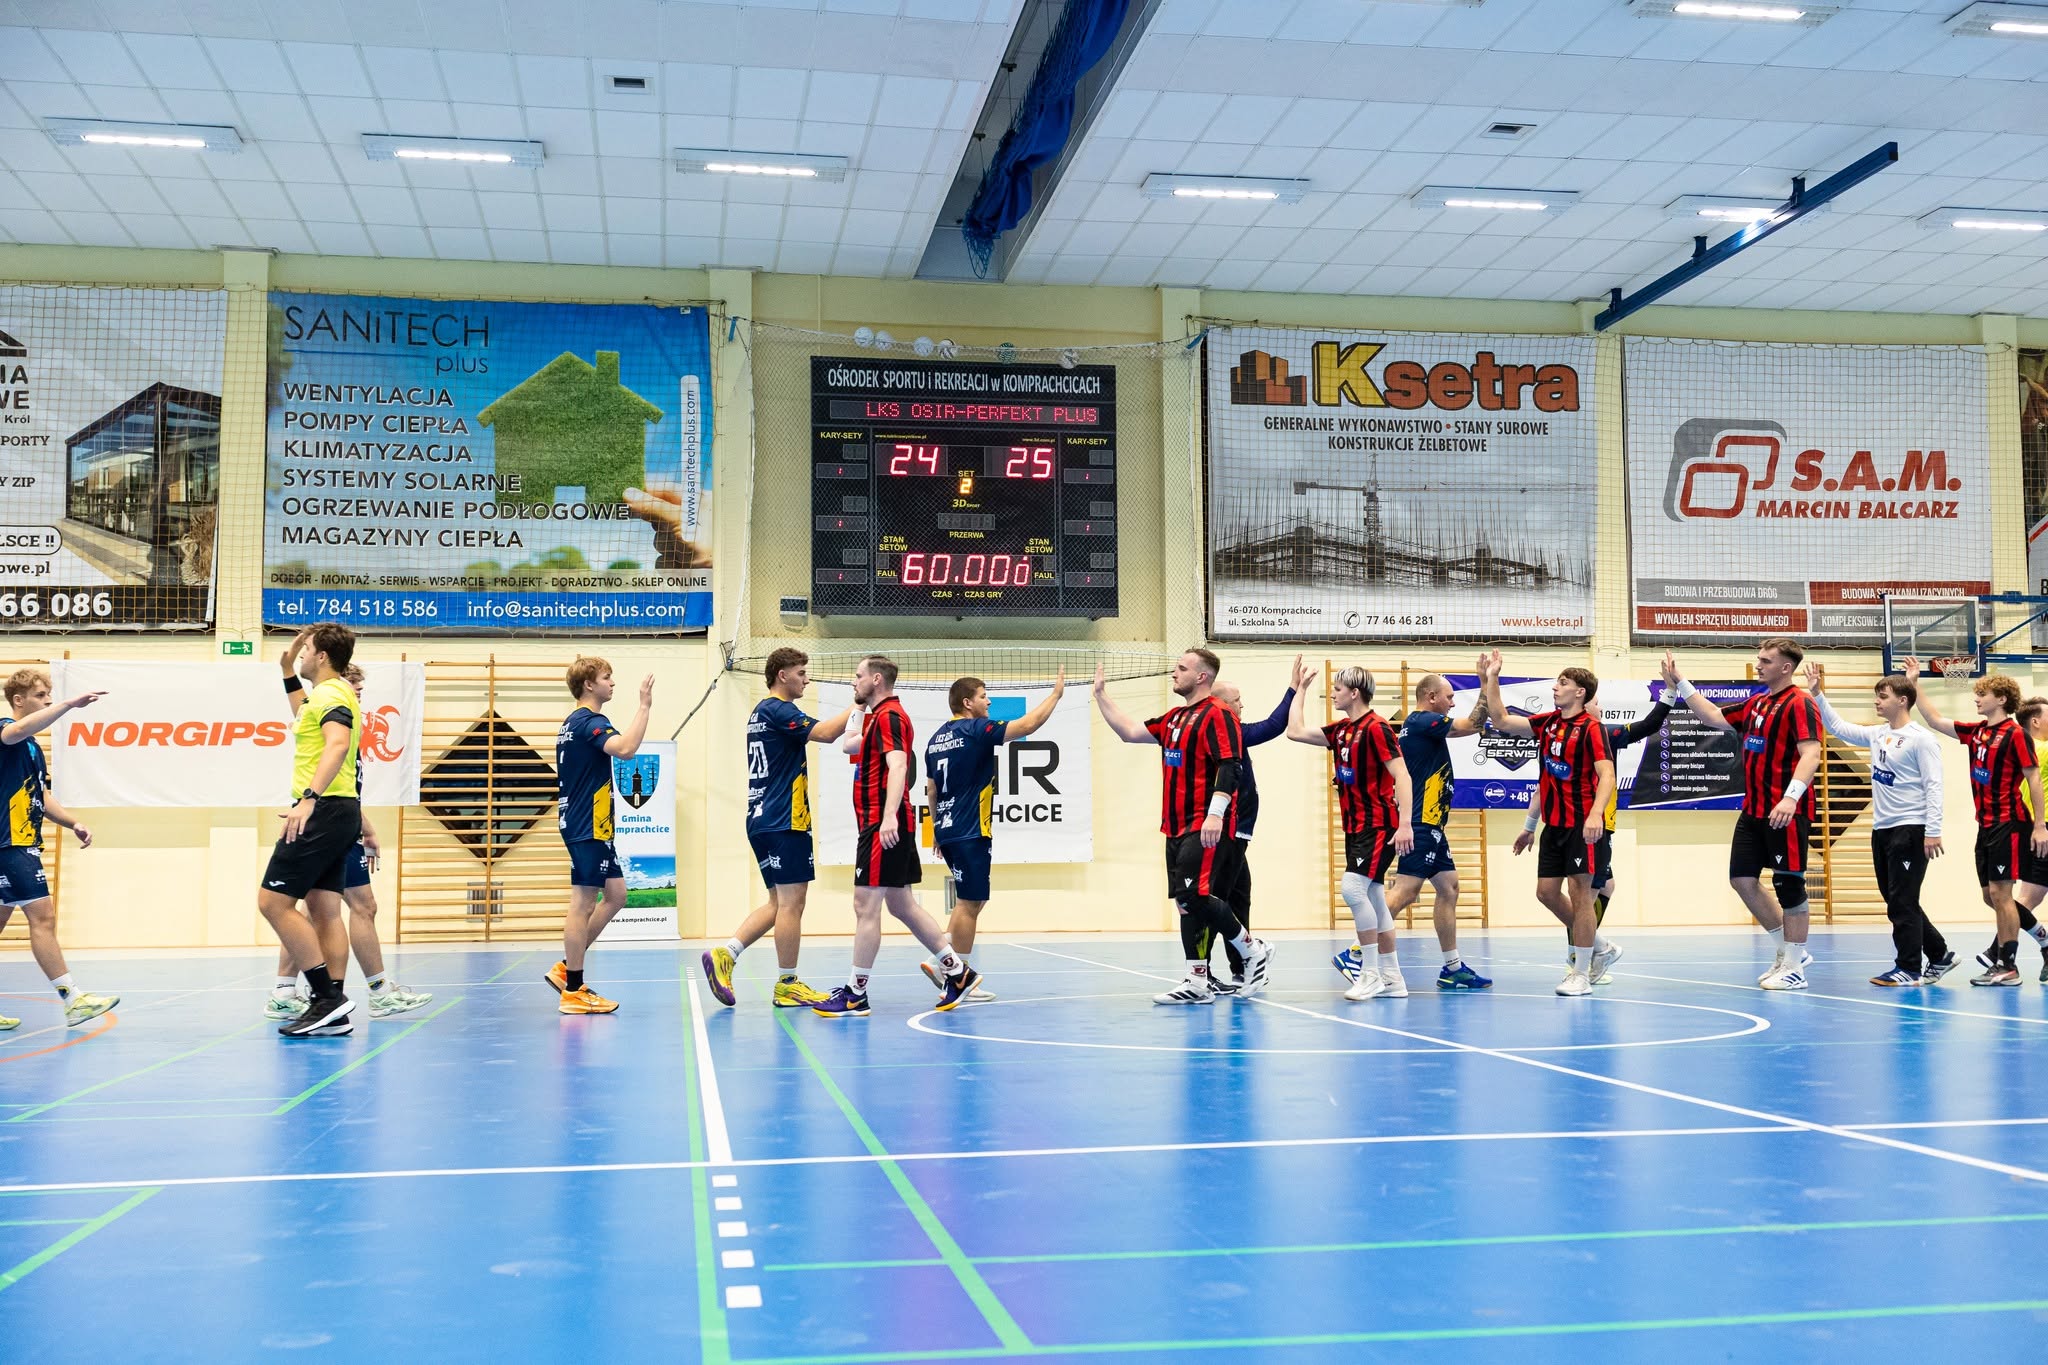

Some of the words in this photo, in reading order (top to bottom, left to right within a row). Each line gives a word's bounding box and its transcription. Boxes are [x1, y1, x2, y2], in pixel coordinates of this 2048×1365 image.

[436, 354, 489, 376] plus
[828, 363, 879, 388] OŚRODEK
[883, 370, 925, 389] SPORTU
[928, 371, 932, 389] i
[934, 372, 988, 391] REKREACJI
[990, 377, 1000, 391] w
[1003, 374, 1100, 394] KOMPRACHCICACH
[1312, 341, 1580, 412] Ksetra
[284, 383, 454, 407] WENTYLACJA
[4, 415, 30, 424] Król
[866, 402, 900, 417] LKS
[911, 403, 1043, 420] OSIR-PERFEKT
[1054, 407, 1097, 422] PLUS
[284, 412, 374, 433] POMPY
[382, 415, 469, 435] CIEPŁA
[1264, 416, 1334, 432] GENERALNE
[1338, 418, 1443, 434] WYKONAWSTWO
[1454, 420, 1494, 435] STANY
[1497, 421, 1549, 436] SUROWE
[284, 440, 473, 463] KLIMATYZACJA
[1328, 435, 1414, 451] KONSTRUKCJE
[1418, 434, 1488, 453] ŻELBETOWE
[684, 390, 695, 527] www.sanitechplus.com
[890, 444, 939, 475] 24
[1006, 447, 1052, 478] 25
[283, 468, 396, 490] SYSTEMY
[405, 472, 521, 492] SOLARNE
[1790, 449, 1962, 492] S.A.M.
[12, 477, 35, 487] ZIP
[959, 478, 973, 494] 2
[282, 497, 455, 519] OGRZEWANIE
[464, 502, 630, 521] PODŁOGOWE
[1756, 500, 1851, 519] MARCIN
[1858, 501, 1959, 519] BALCARZ
[282, 526, 430, 547] MAGAZYNY
[437, 528, 523, 548] CIEPŁA
[879, 543, 908, 551] SETÓW
[321, 572, 370, 585] MONTAŻ
[379, 575, 420, 586] SERWIS
[429, 576, 485, 587] WSPARCIE
[494, 577, 542, 587] PROJEKT
[552, 577, 622, 587] DORADZTWO
[631, 577, 664, 587] SKLEP
[667, 576, 707, 587] ONLINE
[1664, 585, 1698, 598] BUDOWA
[1703, 586, 1756, 599] PRZEBUDOWA
[1758, 585, 1778, 599] DRÓG
[1841, 587, 1875, 599] BUDOWA
[51, 592, 112, 617] 086
[277, 598, 309, 616] tel.
[316, 598, 352, 616] 784
[359, 600, 395, 617] 518
[402, 600, 438, 617] 586
[468, 600, 685, 622] info@sanitechplus.com
[1228, 606, 1259, 615] 46-070
[1261, 605, 1322, 617] Komprachcice
[1228, 618, 1240, 627] ul.
[1241, 618, 1276, 628] Szkolna
[1277, 618, 1290, 627] 5A
[1366, 615, 1379, 626] 77
[1382, 615, 1396, 626] 46
[1398, 615, 1412, 626] 46
[1415, 615, 1434, 626] 281
[1501, 615, 1584, 631] www.ksetra.pl
[1655, 613, 1694, 625] WYNAJEM
[1695, 614, 1730, 627] SPRZĘTU
[1731, 615, 1789, 627] BUDOWLANEGO
[1821, 615, 1878, 627] KOMPLEKSOWE
[1605, 711, 1620, 719] 057
[1623, 711, 1636, 719] 177
[68, 721, 288, 747] NORGIPS
[1480, 739, 1515, 747] SPEC
[1487, 750, 1537, 758] SERWIS
[937, 758, 949, 793] 7
[1510, 792, 1529, 802] +48
[616, 825, 670, 834] mprachcice
